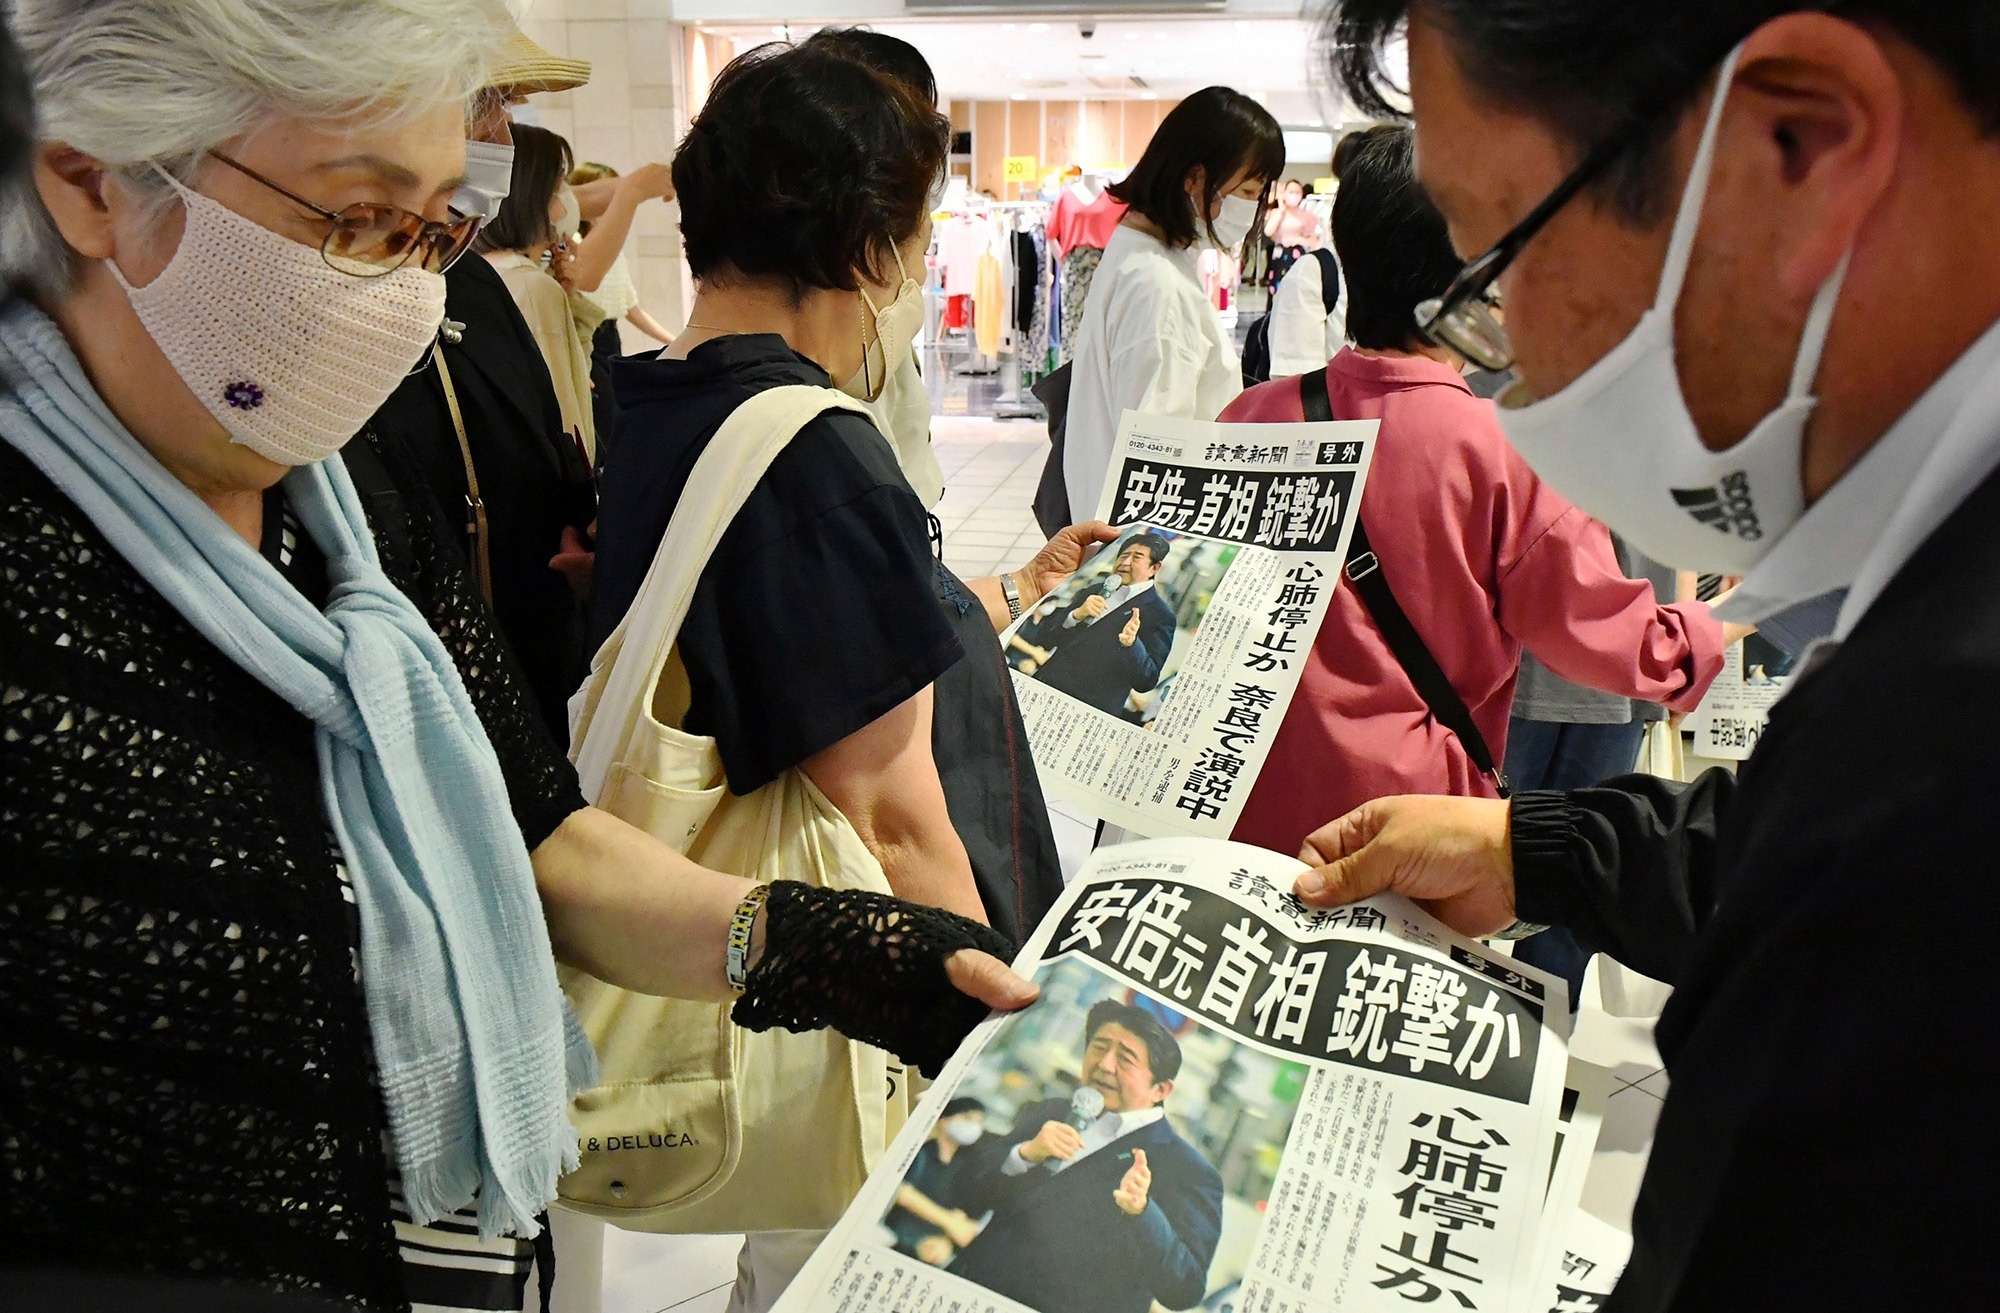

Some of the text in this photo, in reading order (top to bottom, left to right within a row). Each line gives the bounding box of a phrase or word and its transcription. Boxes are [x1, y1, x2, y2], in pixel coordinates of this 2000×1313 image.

[1322, 443, 1357, 463] 号外
[1117, 465, 1342, 547] 安倍元首相 銃撃か
[1242, 561, 1323, 673] 心肺停止か
[1176, 682, 1278, 821] 奈良で演説中
[1058, 882, 1522, 1082] 安倍元首相 銃撃か
[1463, 952, 1533, 991] 号外
[587, 1136, 601, 1152] &
[1369, 1106, 1511, 1311] 心肺停止か
